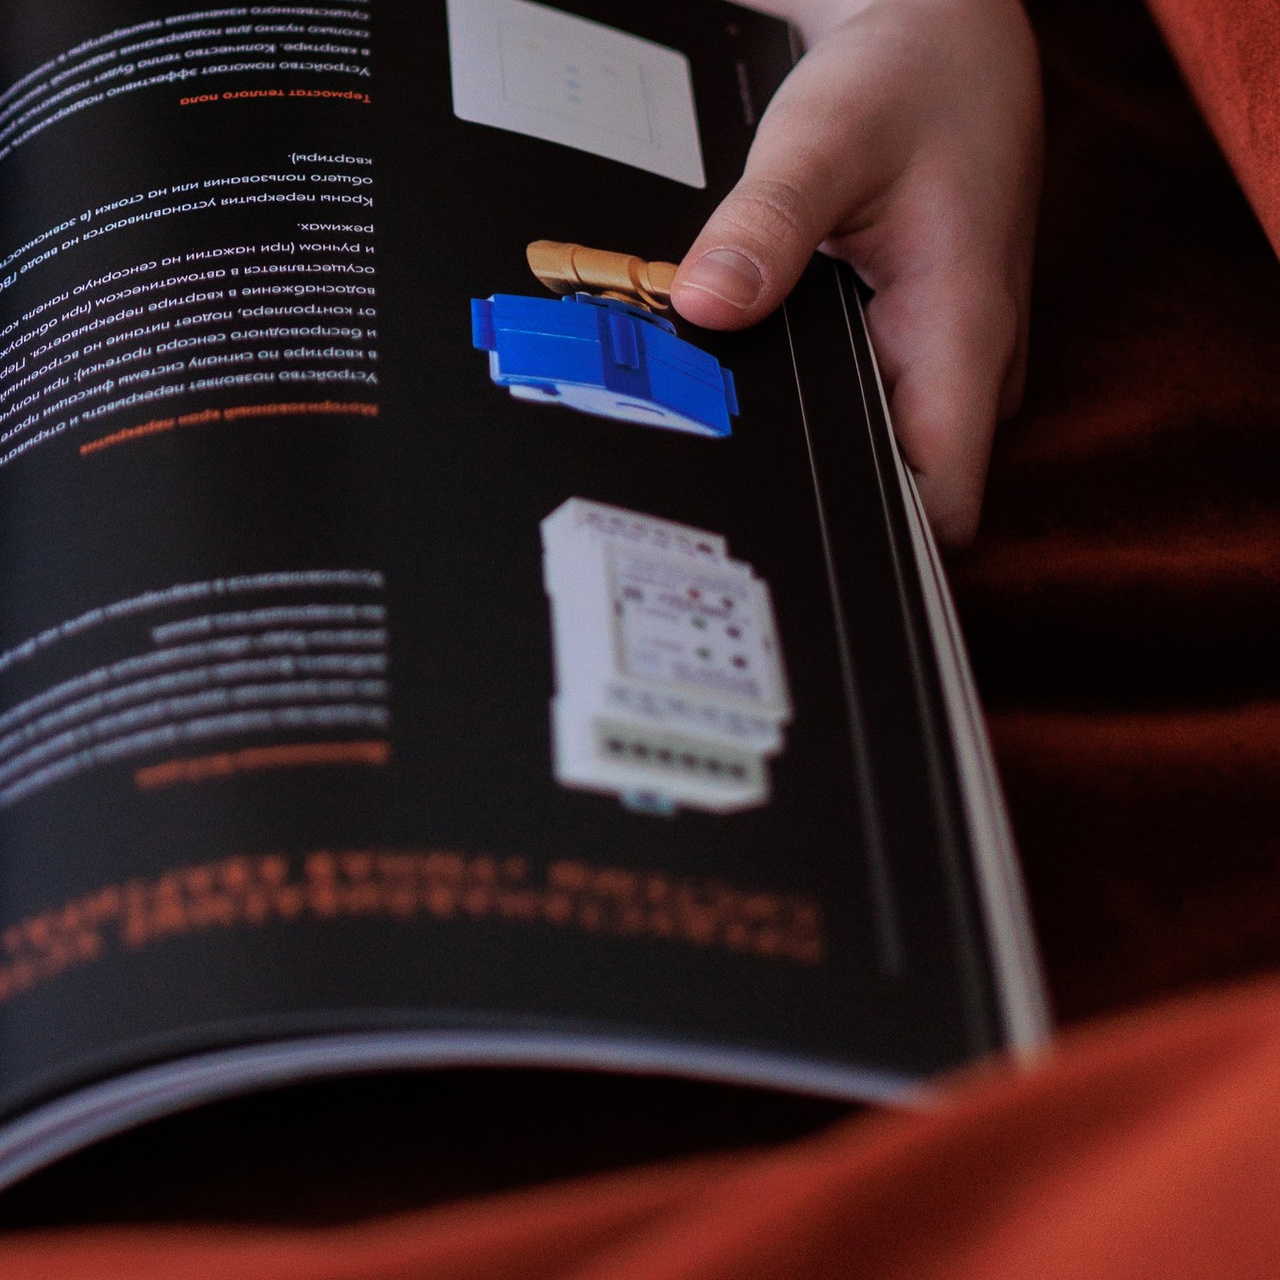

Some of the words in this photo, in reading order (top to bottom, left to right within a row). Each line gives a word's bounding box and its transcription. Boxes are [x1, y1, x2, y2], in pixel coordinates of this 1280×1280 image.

[250, 7, 369, 20] существенного
[225, 25, 251, 34] для
[254, 24, 304, 32] нужно
[308, 26, 369, 38] сколько
[184, 44, 276, 58] Количество
[279, 42, 357, 54] квартире.
[137, 53, 181, 68] тепла
[94, 64, 135, 83] будет
[201, 63, 276, 74] помогает
[279, 62, 370, 76] Устройство
[106, 69, 196, 97] эффективно
[180, 94, 218, 105] пола
[223, 90, 284, 99] теплого
[289, 90, 370, 103] Термостат
[288, 153, 372, 164] квартиры).
[204, 174, 306, 187] пользования
[311, 175, 373, 186] общего
[148, 188, 167, 198] на
[172, 182, 198, 193] или
[95, 194, 144, 215] стояки
[221, 192, 315, 205] перекрытия
[321, 195, 373, 207] Краны
[80, 210, 91, 222] (в
[83, 198, 216, 240] устанавливаются
[297, 223, 374, 233] режимах.
[62, 237, 79, 250] на
[261, 242, 295, 254] (при
[299, 243, 360, 252] ручном
[20, 247, 57, 273] вводе
[186, 246, 255, 261] нажатии
[162, 256, 181, 266] на
[244, 264, 375, 274] осуществляется
[73, 262, 157, 294] сенсорную
[95, 270, 225, 307] автоматическом
[228, 289, 236, 297] в
[242, 285, 375, 295] водоснабжение
[22, 292, 68, 320] панель
[148, 291, 223, 311] квартире
[62, 301, 91, 321] (при
[238, 304, 352, 317] контроллера,
[357, 308, 376, 316] от
[174, 311, 232, 327] подает
[30, 307, 143, 358] перекрывается.
[106, 322, 170, 345] питание
[230, 325, 362, 340] беспроводного
[367, 329, 377, 337] и
[84, 342, 101, 354] на
[157, 333, 226, 353] сенсора
[258, 351, 279, 359] по
[284, 347, 363, 358] квартире
[368, 351, 377, 359] в
[74, 348, 151, 382] протечки):
[189, 352, 253, 367] сигналу
[0, 351, 79, 402] встроенный
[118, 362, 184, 385] системы
[279, 369, 377, 384] Устройство
[44, 376, 69, 394] при
[189, 373, 275, 391] позволяет
[43, 380, 114, 417] фиксации
[82, 384, 184, 419] перекрывать
[70, 416, 78, 426] и
